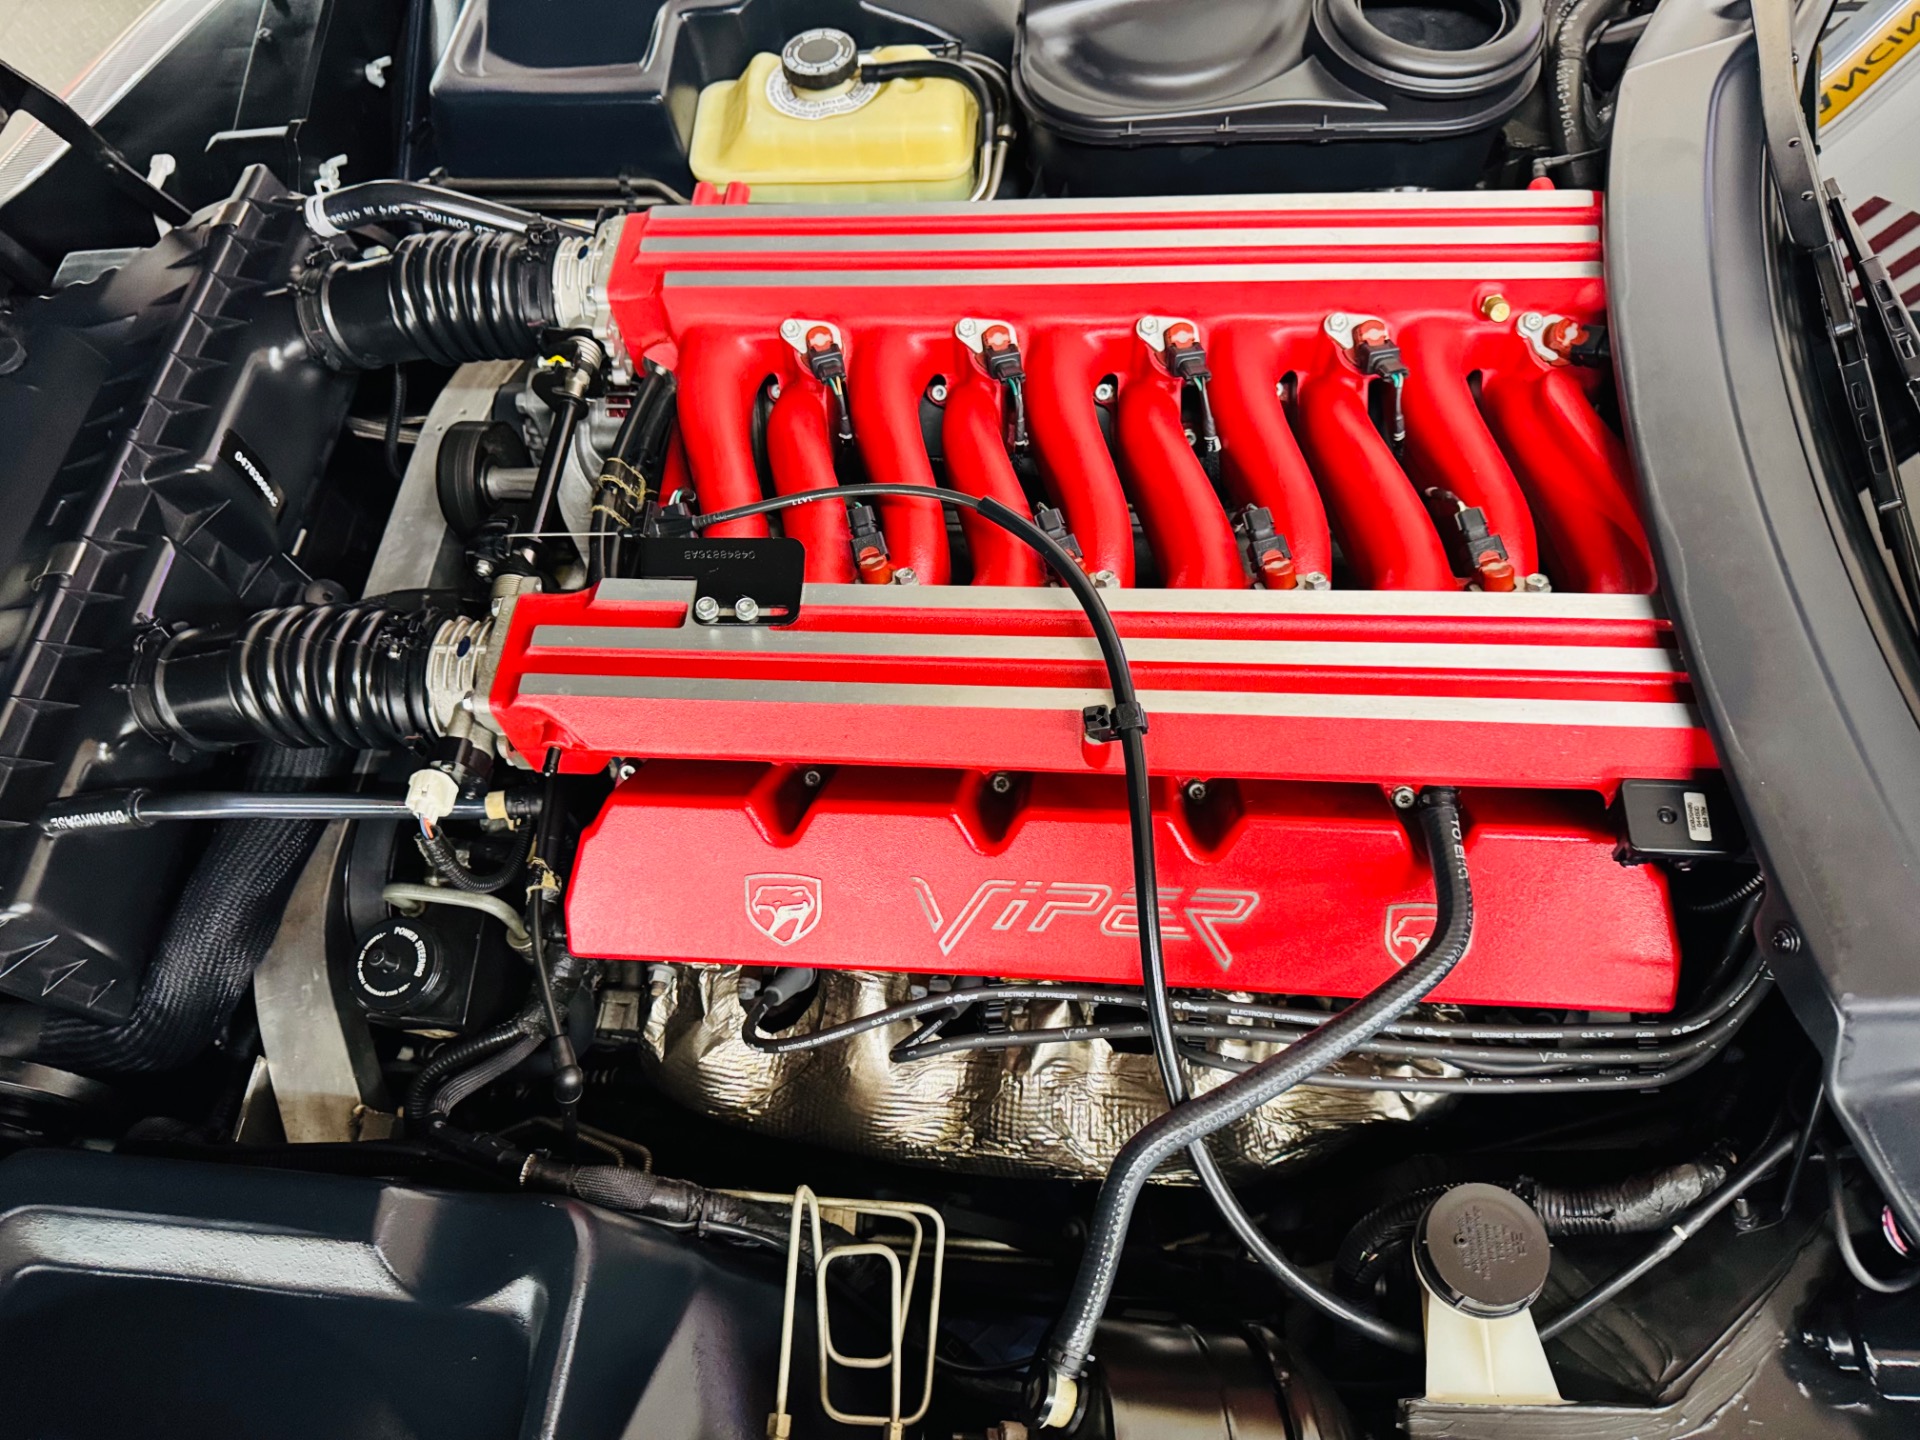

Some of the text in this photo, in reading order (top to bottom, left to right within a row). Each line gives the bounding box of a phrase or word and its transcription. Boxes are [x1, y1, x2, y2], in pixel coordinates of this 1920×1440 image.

[418, 209, 470, 230] CONTROL
[49, 809, 126, 830] CRANKCASE
[1450, 819, 1462, 840] TO
[393, 926, 427, 977] POWER STEERING
[777, 1040, 813, 1052] ELECTRONIC
[812, 1027, 856, 1044] SUPPRESSION
[1035, 991, 1078, 1000] SUPPRESSION
[1230, 1008, 1273, 1019] ELECTRONIC
[1273, 1012, 1320, 1025] SUPPRESSION
[1472, 1031, 1514, 1039] ELECTRONIC
[1514, 1031, 1564, 1039] SUPPRESSION
[1185, 1107, 1237, 1138] VACUUM
